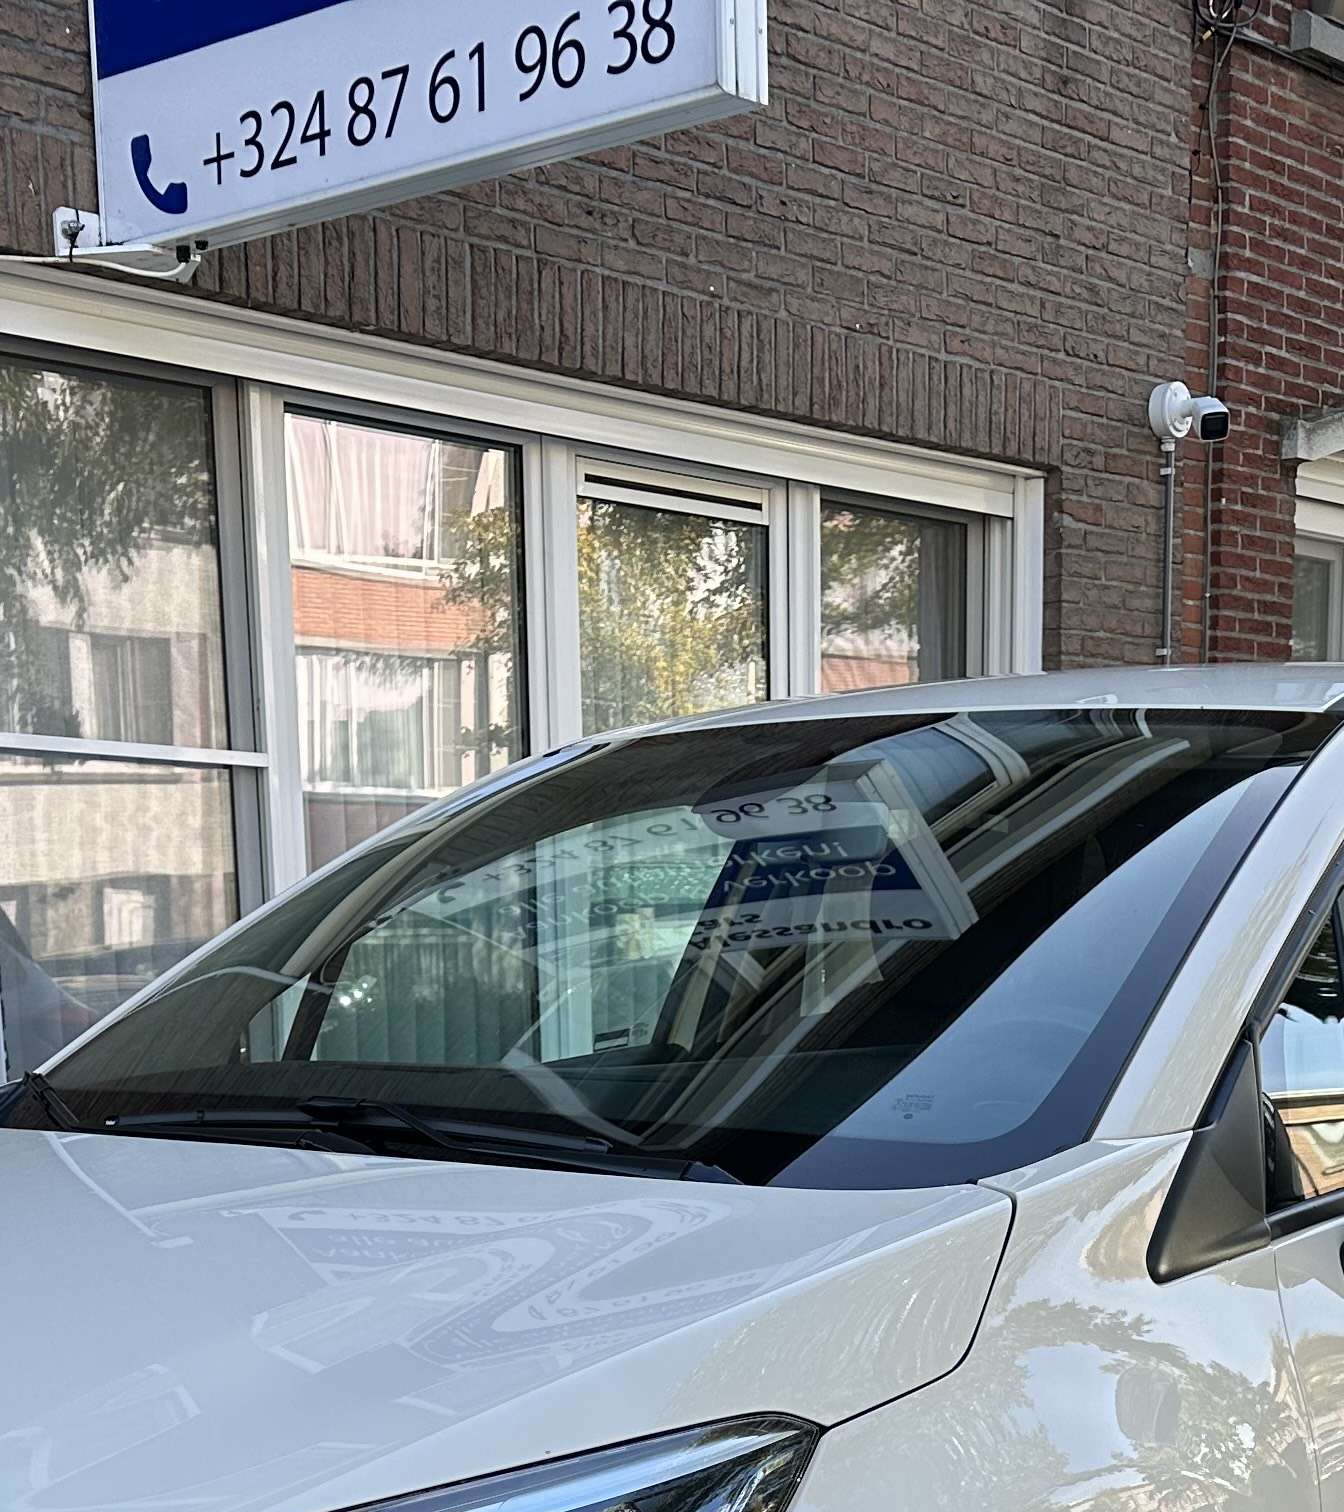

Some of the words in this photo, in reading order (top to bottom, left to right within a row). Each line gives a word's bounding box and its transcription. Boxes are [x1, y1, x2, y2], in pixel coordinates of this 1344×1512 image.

[202, 90, 331, 185] +324
[347, 64, 410, 147] 87
[428, 41, 487, 124] 61
[515, 12, 585, 101] 96
[606, 0, 675, 75] 38
